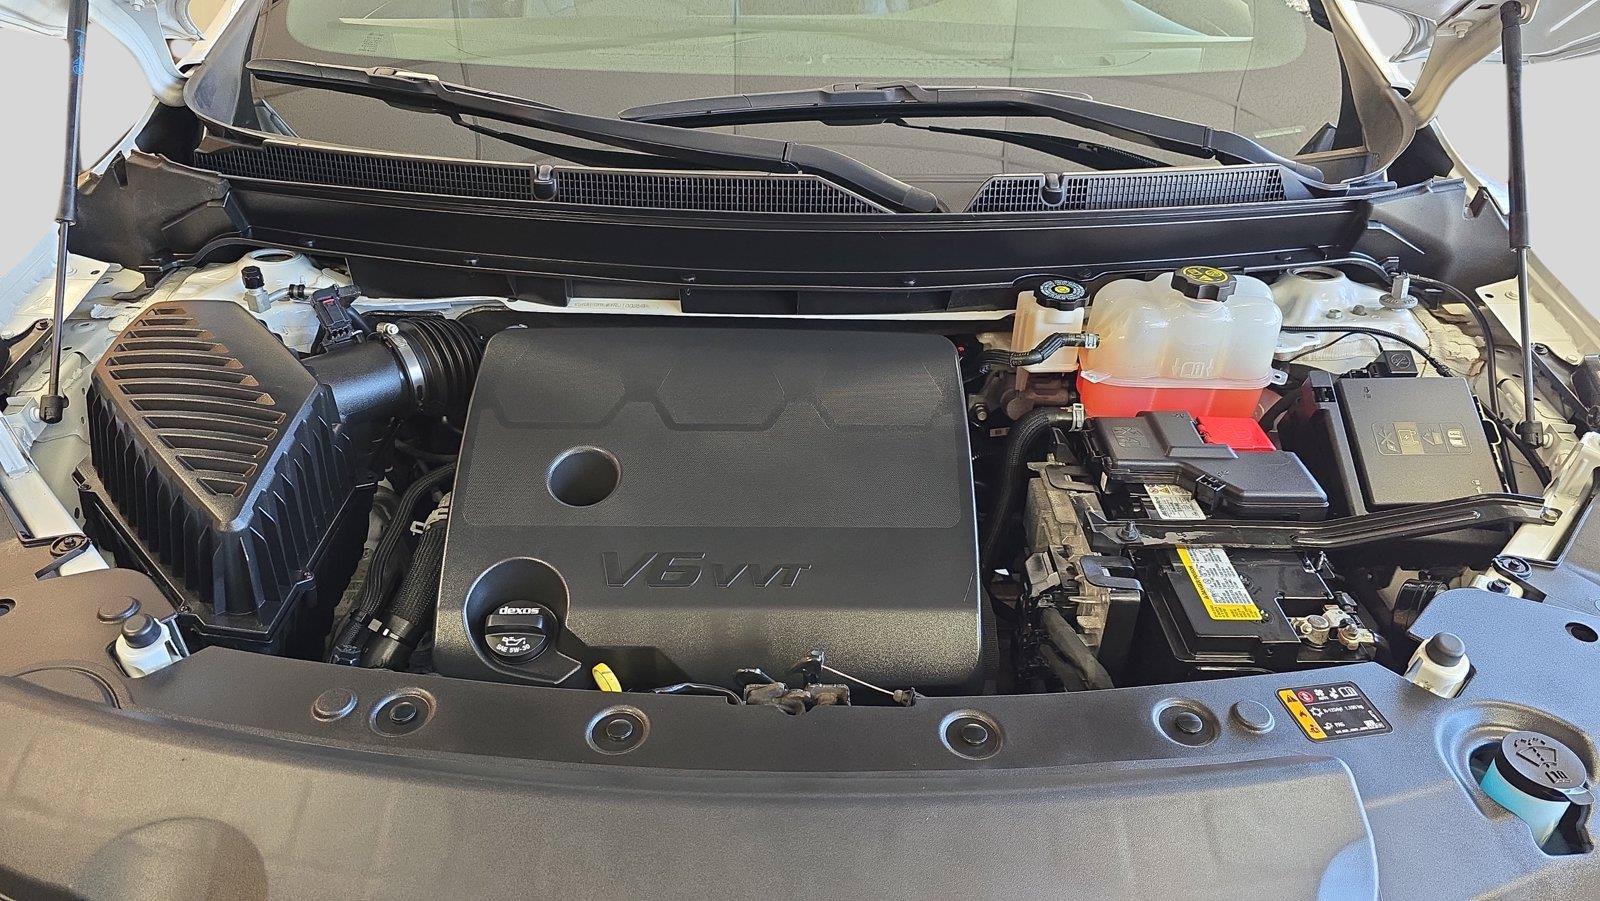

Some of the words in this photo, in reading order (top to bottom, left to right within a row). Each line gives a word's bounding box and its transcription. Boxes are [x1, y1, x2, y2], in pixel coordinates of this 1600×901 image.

[602, 551, 706, 588] V6
[712, 563, 812, 588] VVT
[499, 606, 541, 615] dexos
[496, 644, 508, 652] SAE
[509, 644, 531, 653] 5W-30
